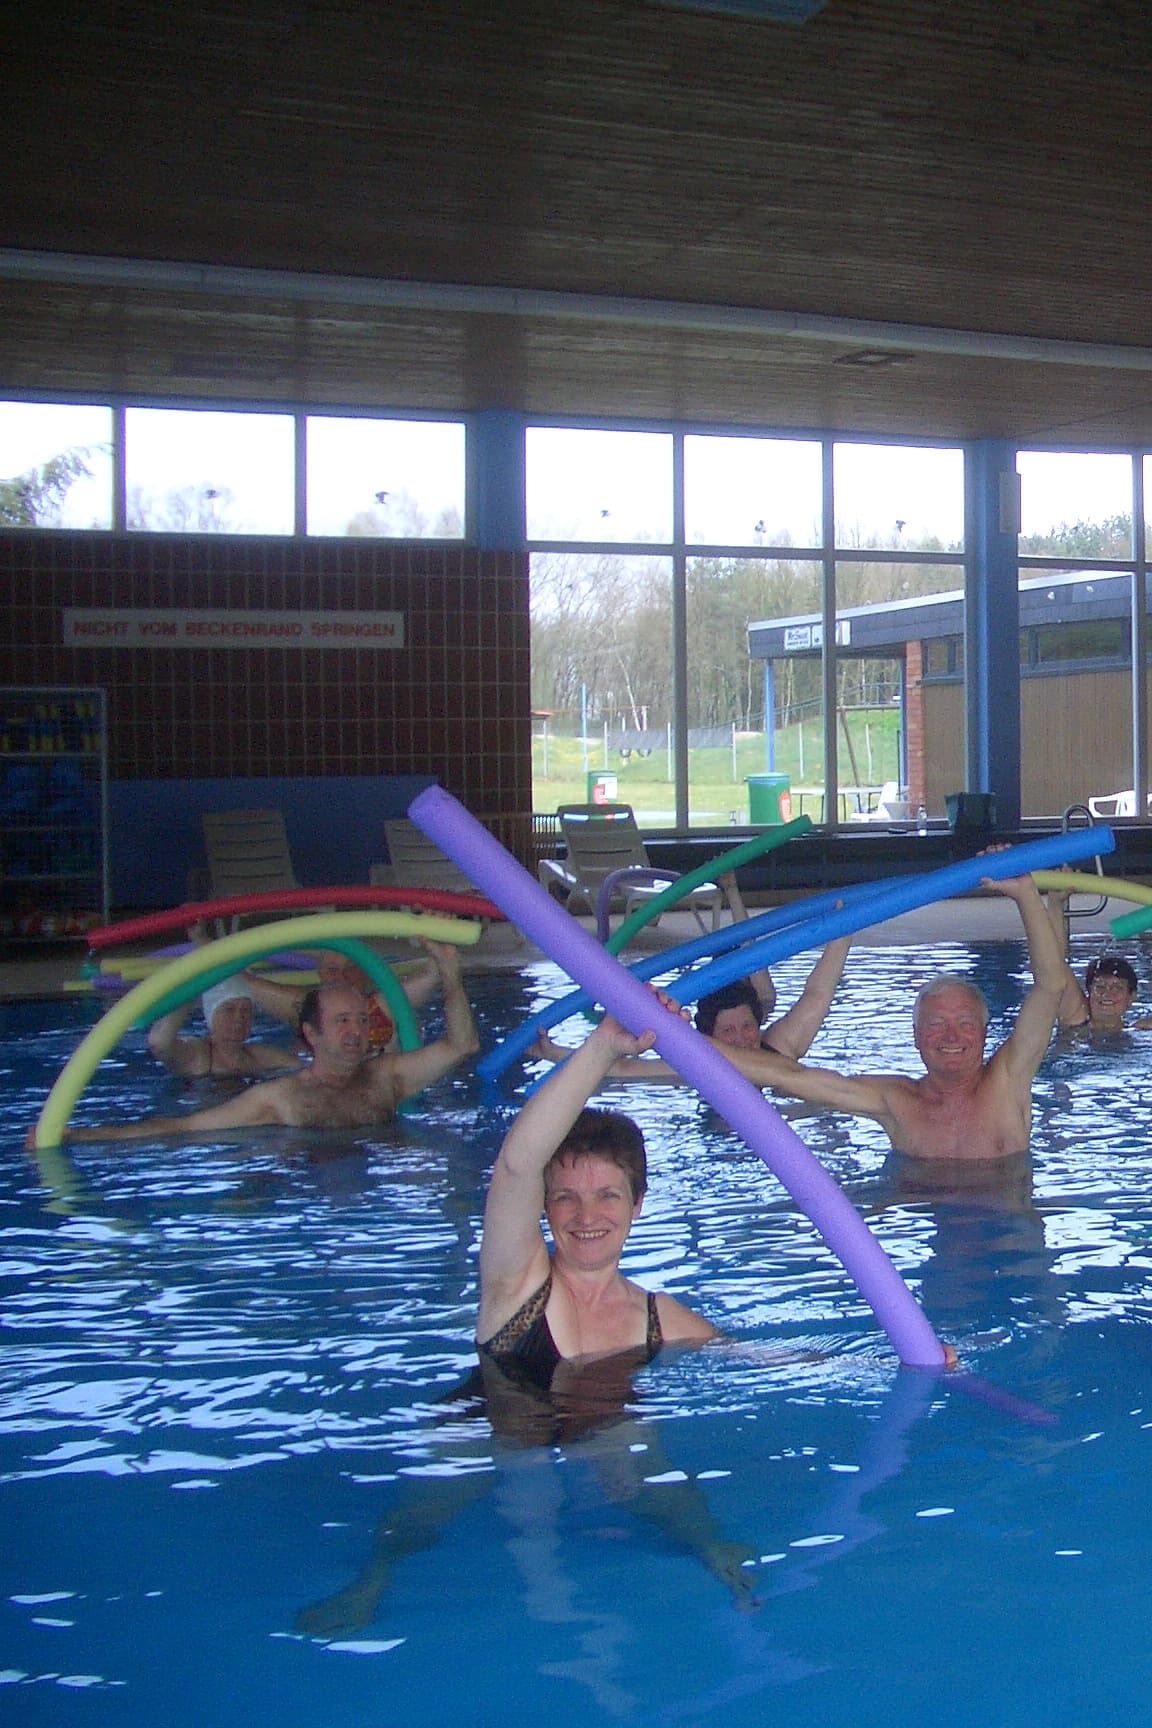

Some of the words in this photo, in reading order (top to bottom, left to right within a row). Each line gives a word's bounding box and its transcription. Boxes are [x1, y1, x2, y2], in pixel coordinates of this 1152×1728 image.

[73, 621, 129, 636] NICHT
[138, 621, 178, 636] VOM
[185, 621, 304, 637] BECKENRAND
[311, 621, 396, 637] SPRINGEN
